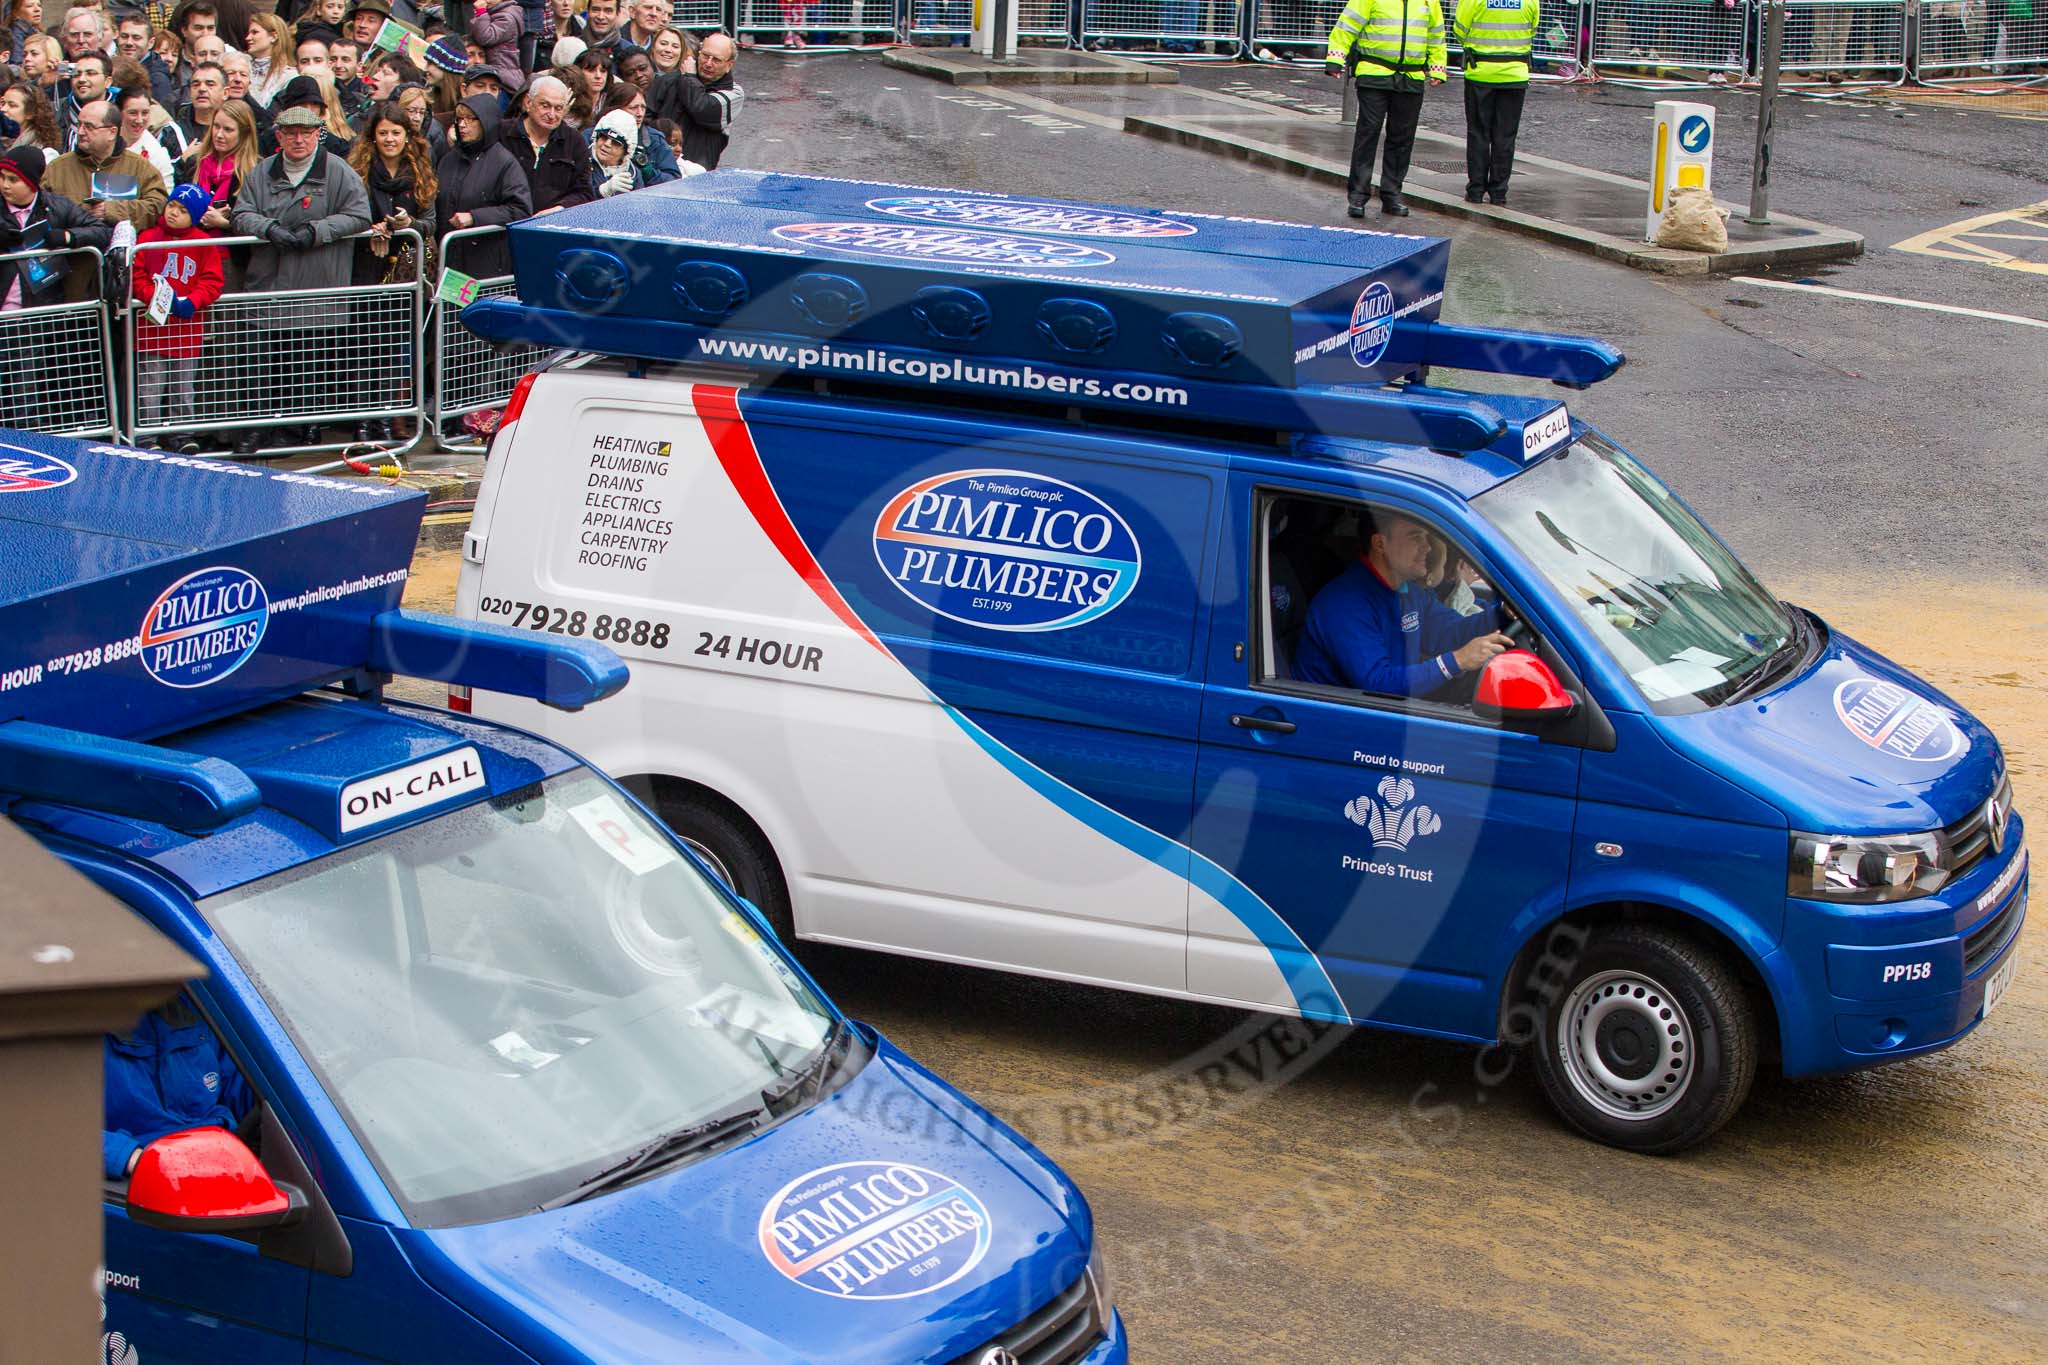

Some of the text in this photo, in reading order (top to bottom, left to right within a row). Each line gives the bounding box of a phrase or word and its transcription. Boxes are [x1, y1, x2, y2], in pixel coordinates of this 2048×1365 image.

[1487, 0, 1520, 8] POLICE
[801, 233, 1078, 266] PLUMBERS
[830, 225, 1092, 257] PIMLICO
[1355, 292, 1391, 325] PIMLICO
[1353, 323, 1391, 355] PLUMBERS
[699, 338, 1188, 405] www.pimlicoplumbers.com
[593, 434, 659, 455] HEATING
[1525, 415, 1567, 449] ON-CALL
[590, 454, 669, 476] PLUMBING
[587, 473, 644, 493] DRAINS
[968, 479, 1064, 502] The Pimlico Group plc
[585, 492, 662, 514] ELECTRICS
[582, 511, 674, 535] APPLIANCES
[903, 490, 1113, 553] PIMLICO
[581, 531, 668, 554] CARPENTRY
[578, 549, 648, 571] ROOFING
[897, 547, 1115, 606] PLUMBERS
[153, 580, 257, 633] PIMLICO
[269, 567, 408, 615] www.pimlicoplumbers.com
[152, 620, 258, 674] PLUMBERS
[592, 614, 671, 649] 8888
[0, 664, 43, 692] HOUR
[104, 636, 142, 664] 8888
[694, 631, 824, 672] 24 HOUR
[1846, 682, 1907, 735] PIMLICO
[1885, 702, 1943, 757] PLUMBERS
[1353, 750, 1445, 775] Proud to support
[346, 760, 477, 816] ON-CALL
[1342, 855, 1433, 882] Prince's Trust
[1882, 961, 1932, 983] PP158
[766, 1166, 929, 1258] PIMLICO
[816, 1198, 984, 1295] PLUMBERS
